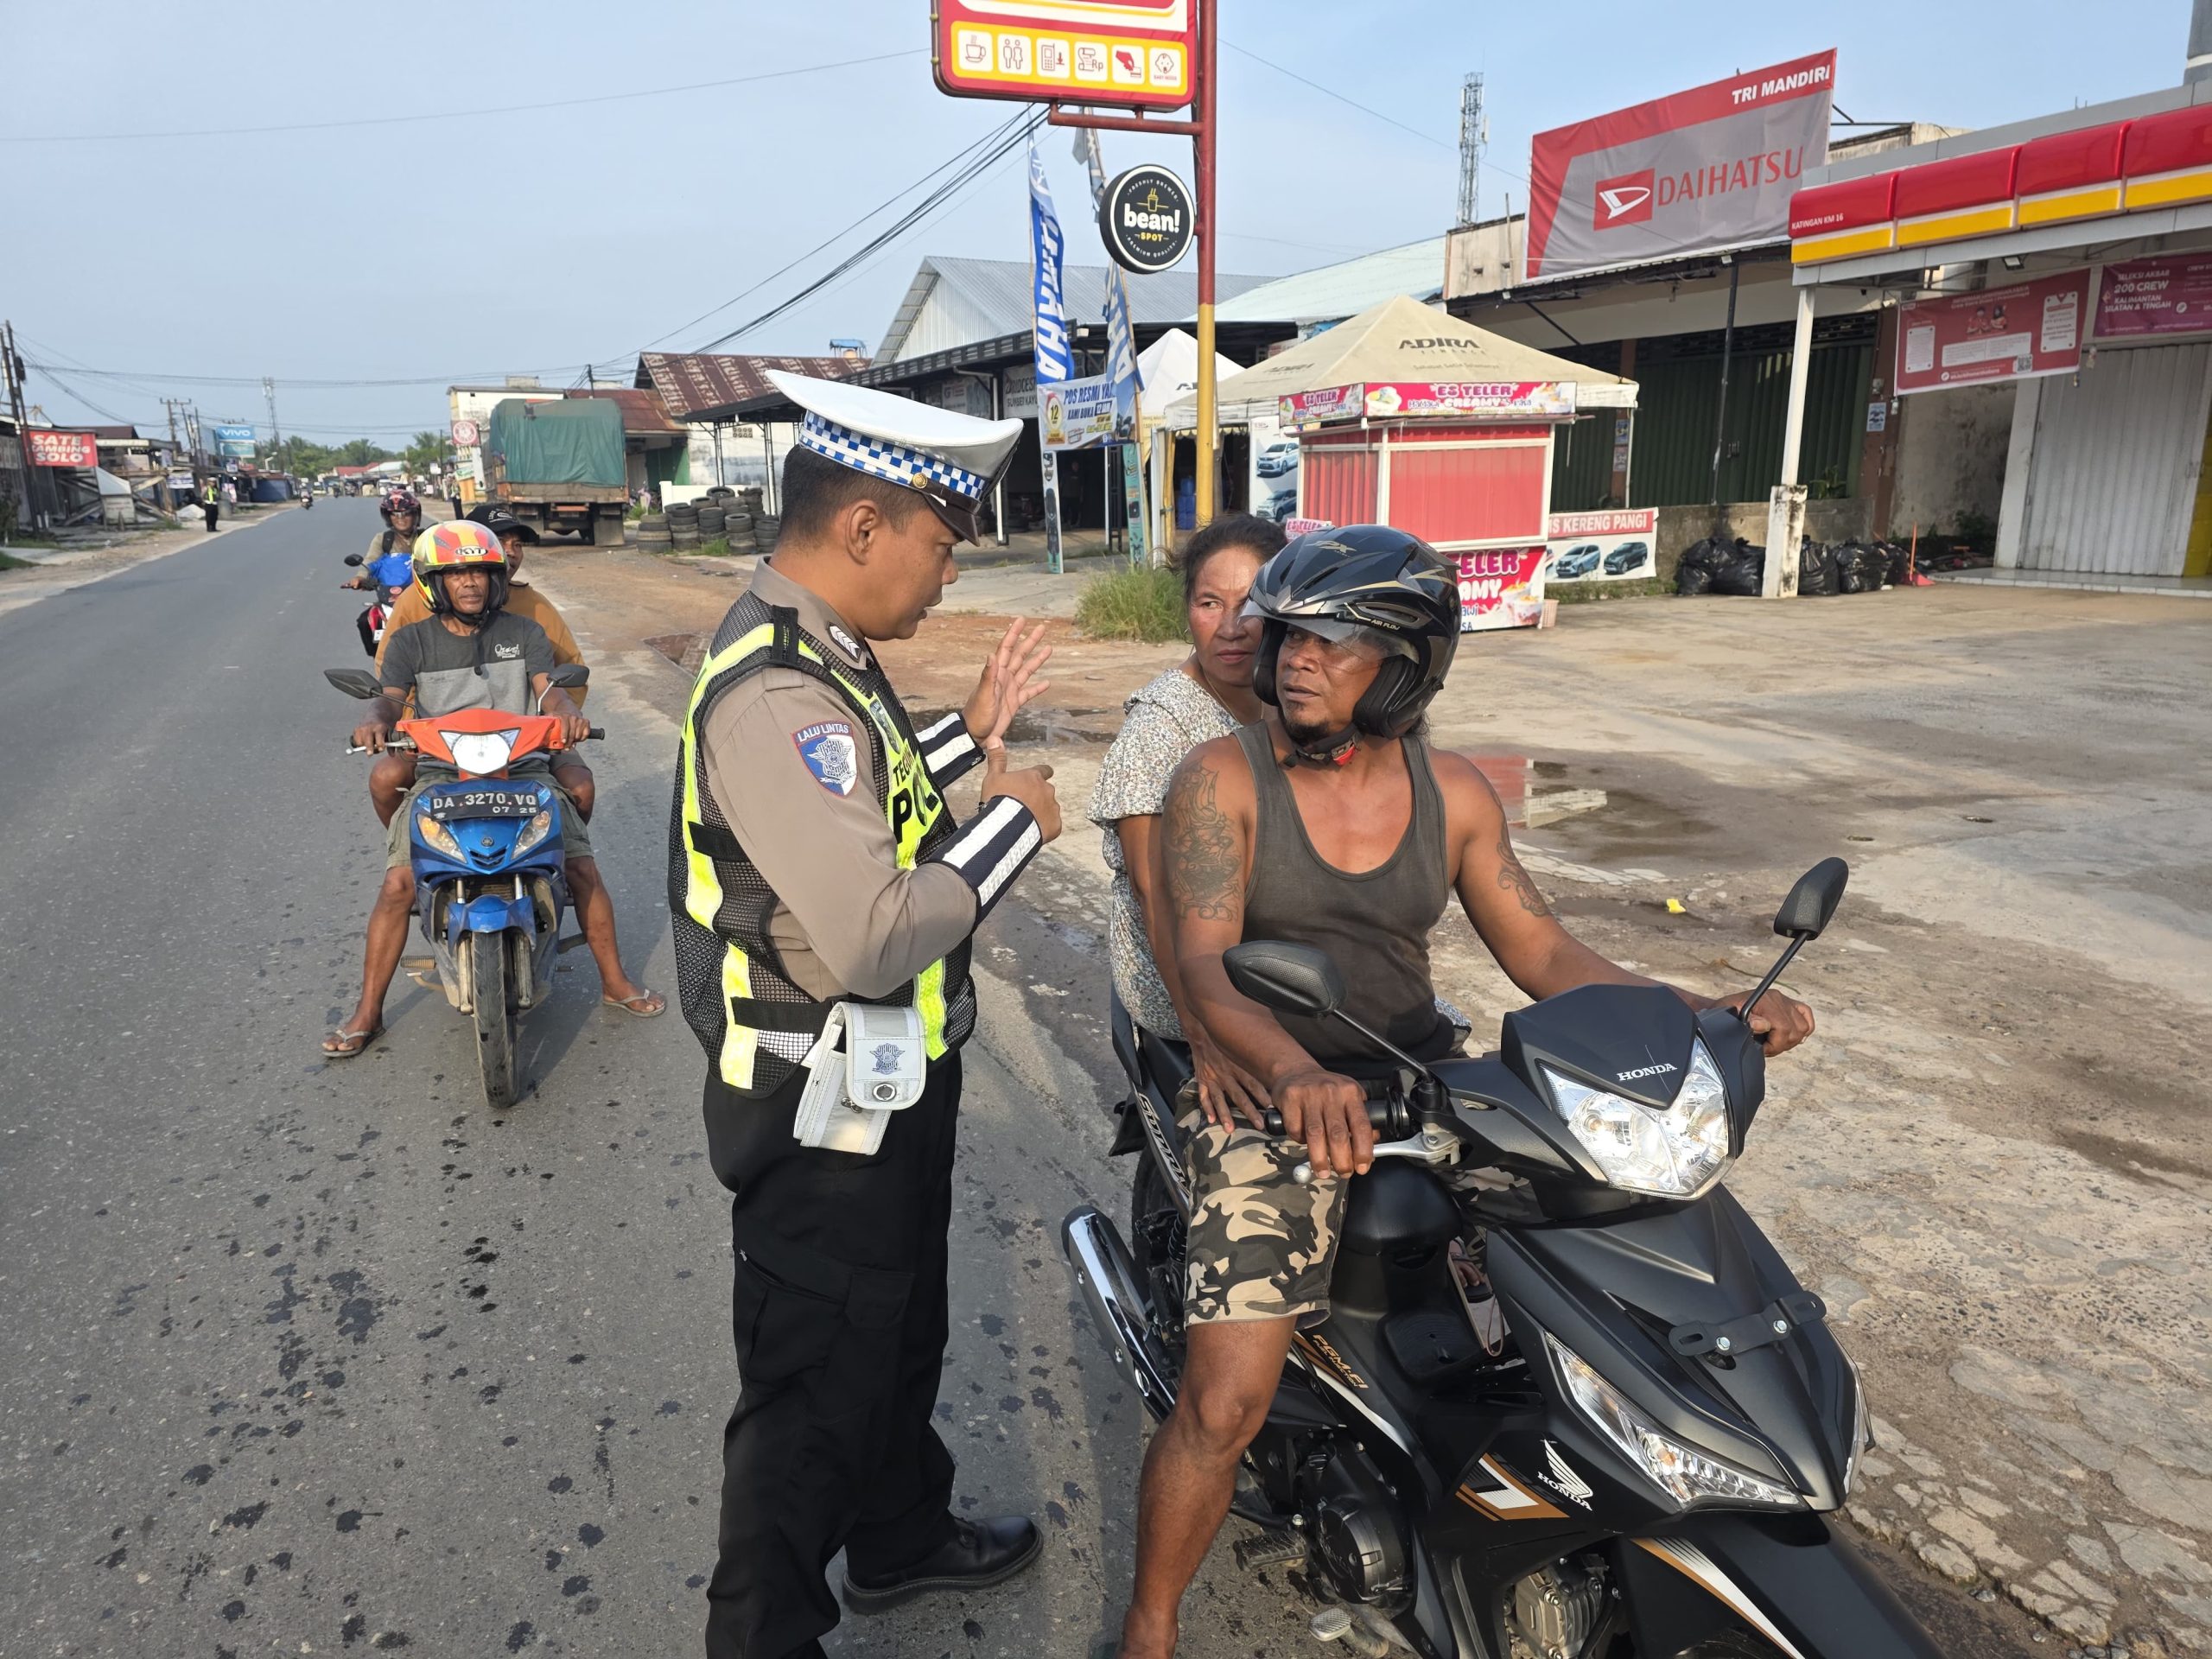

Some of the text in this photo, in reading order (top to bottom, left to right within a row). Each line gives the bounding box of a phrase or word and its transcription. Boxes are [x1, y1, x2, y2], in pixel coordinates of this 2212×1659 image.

[1732, 64, 1831, 105] TRI MANDIRI
[1657, 145, 1804, 207] DAIHATSU
[1123, 203, 1180, 233] bean!
[1791, 213, 1845, 231] KATINGAN KM 16
[1141, 232, 1163, 242] SPOT
[2113, 280, 2170, 295] 200 CREW
[1398, 337, 1480, 349] ADIRA
[1064, 388, 1078, 404] POS
[1077, 385, 1101, 403] RESMI
[1437, 385, 1513, 396] ES TELER
[1051, 404, 1058, 420] 12
[1443, 398, 1502, 408] CREAMY
[33, 435, 82, 446] SATE
[36, 453, 84, 463] SOLO
[1562, 515, 1611, 533] KERENG
[1613, 513, 1647, 530] PANGI
[1382, 622, 1400, 631] FLOW
[797, 723, 849, 742] LALU LINTAS
[433, 798, 454, 810] DA
[465, 792, 506, 805] 3270
[1616, 1063, 1678, 1081] HONDA
[1537, 1471, 1593, 1511] HONDA
